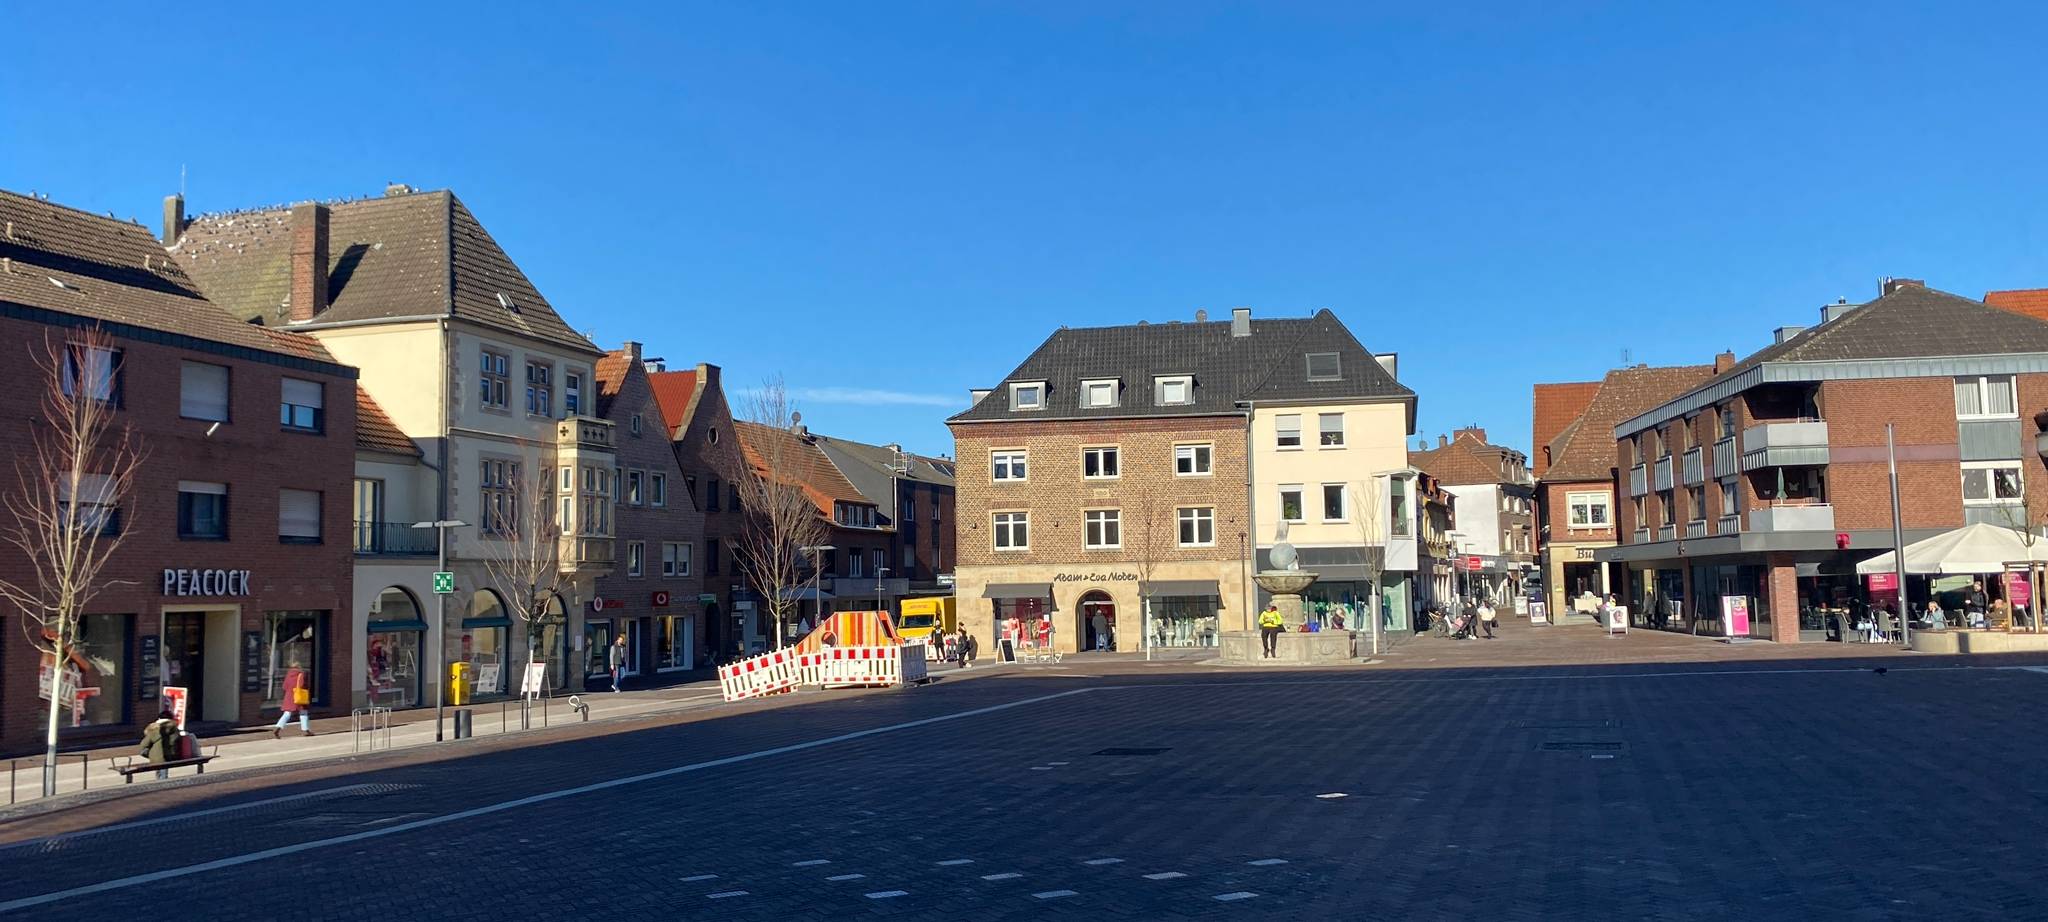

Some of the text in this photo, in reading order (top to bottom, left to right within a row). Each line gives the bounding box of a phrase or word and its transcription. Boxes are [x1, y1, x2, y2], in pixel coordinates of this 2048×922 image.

[163, 568, 251, 596] PEACOCK
[1054, 573, 1082, 582] Adam
[1108, 572, 1138, 581] Moden
